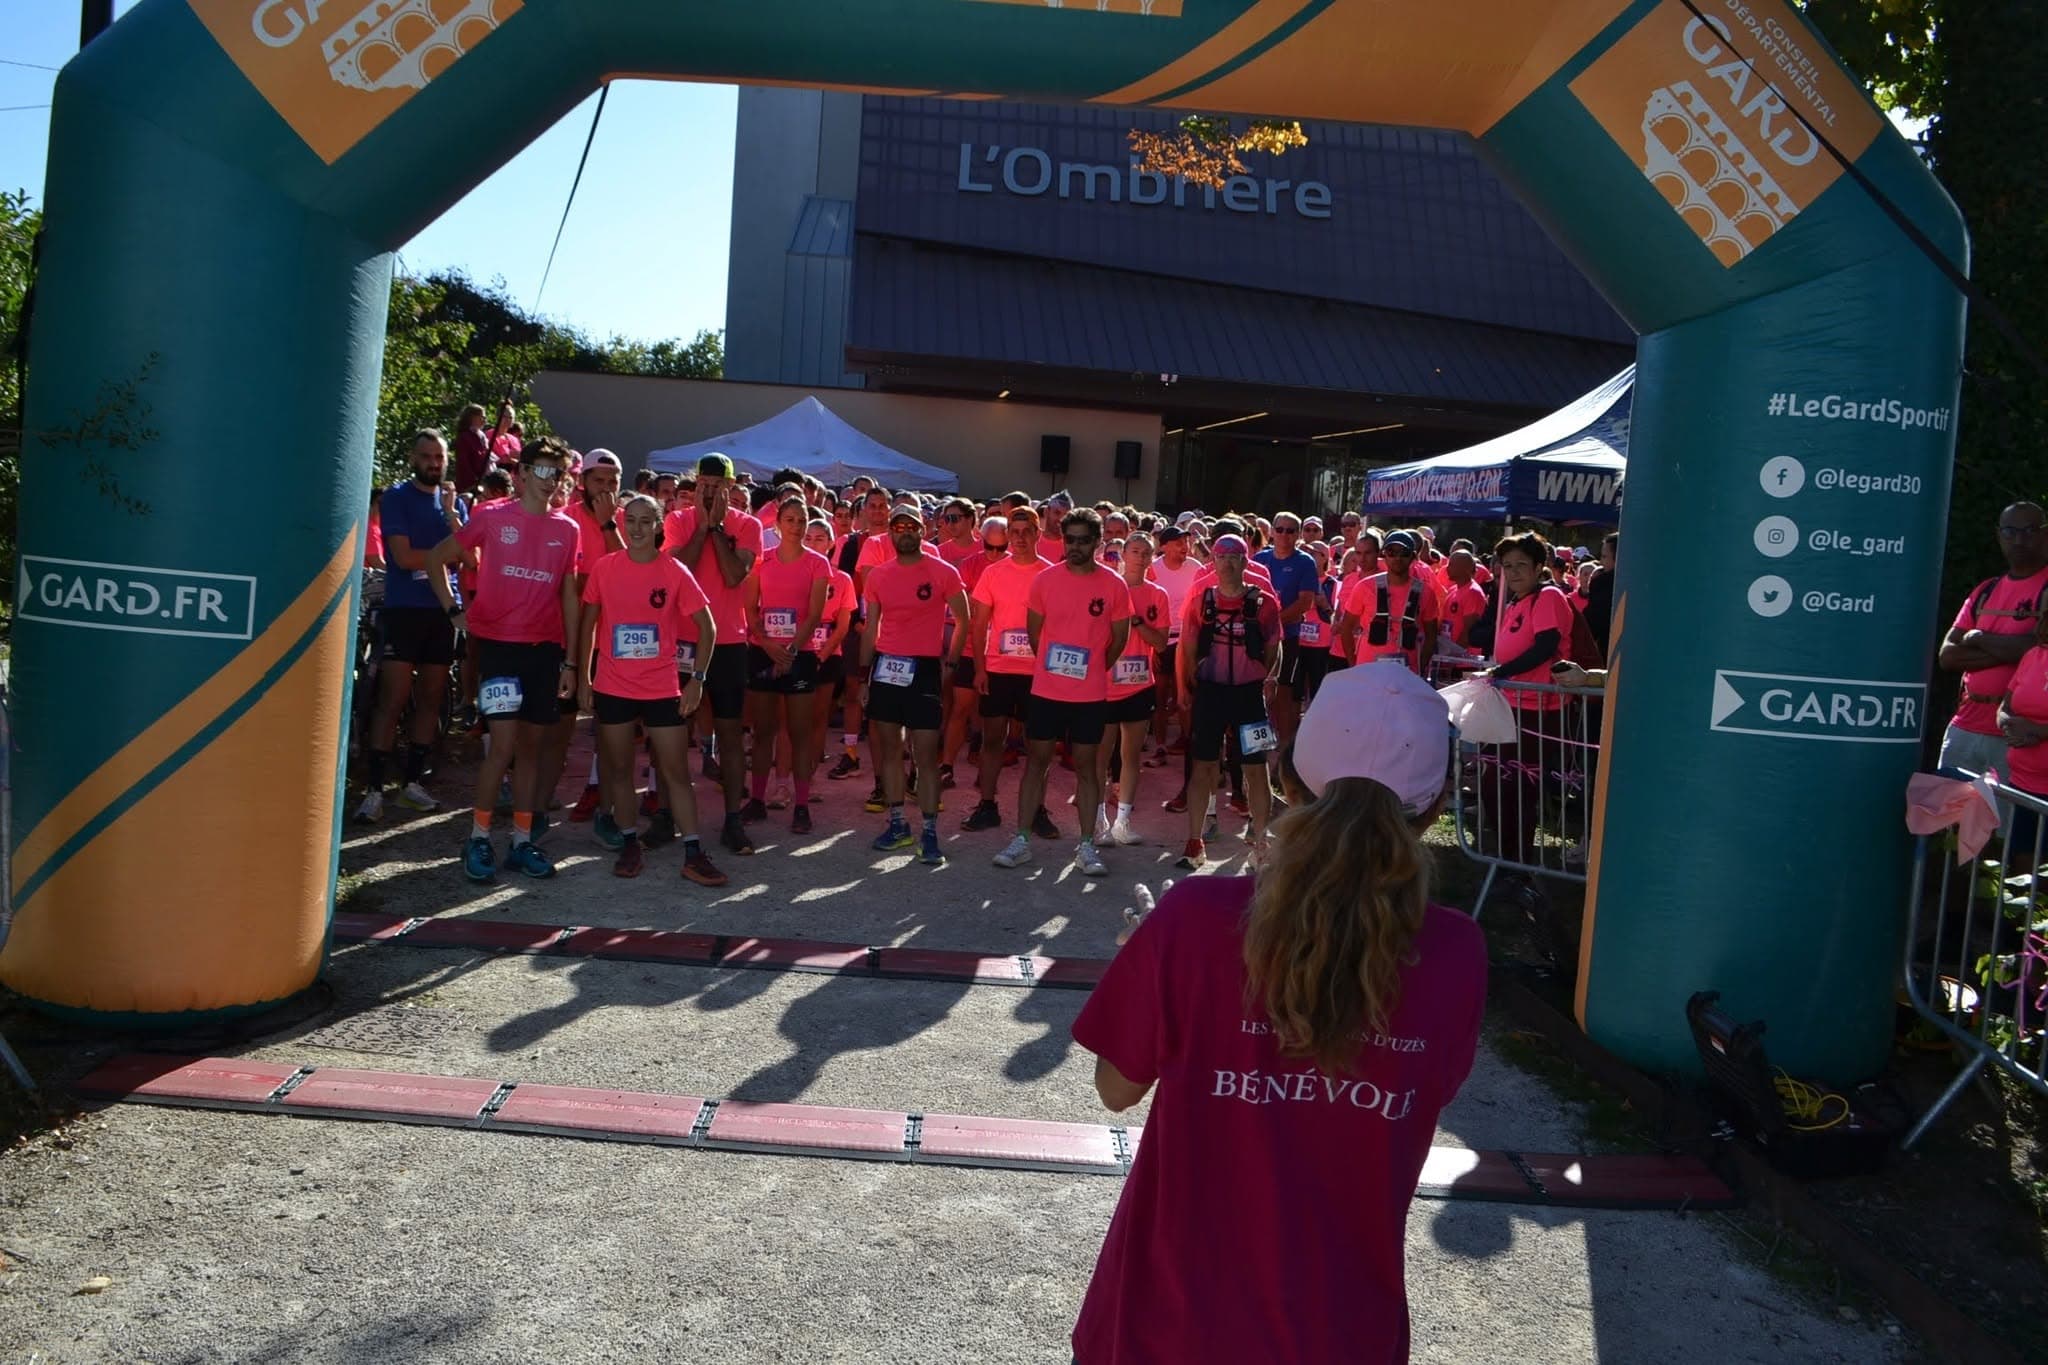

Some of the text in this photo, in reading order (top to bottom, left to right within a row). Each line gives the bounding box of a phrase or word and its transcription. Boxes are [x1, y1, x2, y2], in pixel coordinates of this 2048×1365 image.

[1765, 18, 1822, 84] CONSEIL
[1725, 0, 1839, 127] DÉPARTEMENTAL
[1682, 13, 1820, 167] GARD
[1767, 392, 1950, 431] #LeGardSportif
[1814, 468, 1921, 494] @legard30
[1808, 529, 1905, 556] @le_gard
[40, 572, 229, 622] GARD.FR
[1802, 591, 1875, 613] @Gard
[623, 633, 648, 645] 296
[1009, 635, 1029, 645] 395
[886, 661, 905, 673] 432
[1056, 651, 1080, 665] 175
[1122, 662, 1141, 673] 173
[485, 685, 510, 700] 304
[1759, 688, 1916, 728] GARD.FR
[1253, 728, 1267, 740] 38
[1240, 1019, 1269, 1036] LES
